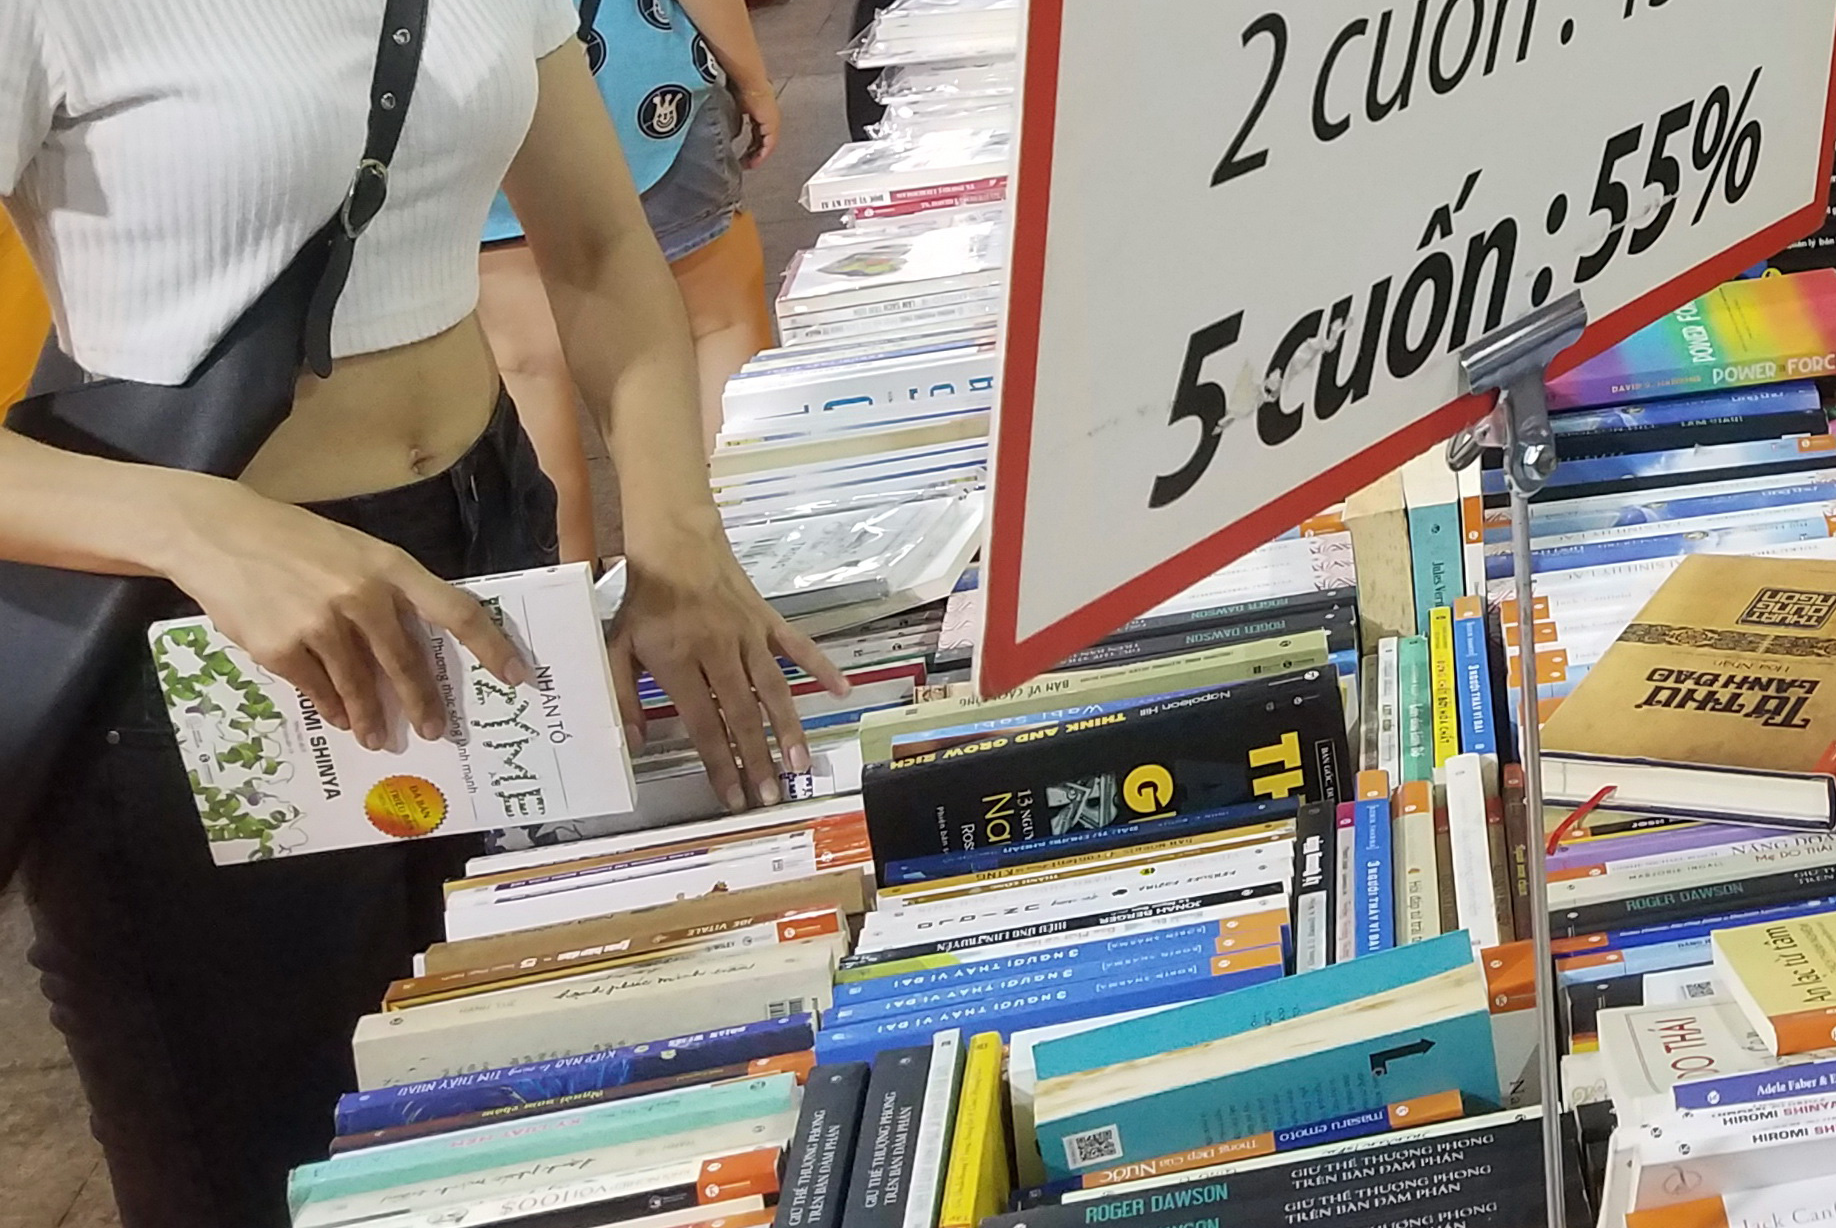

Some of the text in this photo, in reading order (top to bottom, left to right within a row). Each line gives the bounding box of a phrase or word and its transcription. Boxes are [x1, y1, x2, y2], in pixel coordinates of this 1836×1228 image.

[1209, 12, 1288, 188] 2
[1147, 309, 1246, 509] 5
[1255, 167, 1519, 446] cuốn
[1573, 66, 1765, 285] 55%
[1681, 325, 1716, 364] POWER
[1712, 361, 1777, 385] POWER
[1185, 626, 1240, 645] DAWSON
[430, 637, 452, 681] Phương
[446, 710, 466, 737] sống
[460, 764, 479, 794] mạnh
[535, 665, 573, 746] NHÂN TỐ
[890, 689, 1231, 770] Napoleon Hill THINK AND GROW RICH
[1625, 882, 1745, 912] ROGER DAWSON
[686, 921, 728, 938] VITALE
[1722, 1110, 1780, 1127] HIROMI
[1290, 1132, 1496, 1179] GIỮ THẾ THƯỢNG PHONG
[1291, 1150, 1465, 1191] TRÊN BÀN ĐÀM PHÁN
[1084, 1183, 1230, 1225] ROGER DAWSON
[1284, 1163, 1493, 1213] GIỮ THẾ THƯỢNG PHONG
[1285, 1182, 1462, 1224] TRÊN BÀN ĐÀM PHÁN
[1432, 1201, 1499, 1222] PHONG
